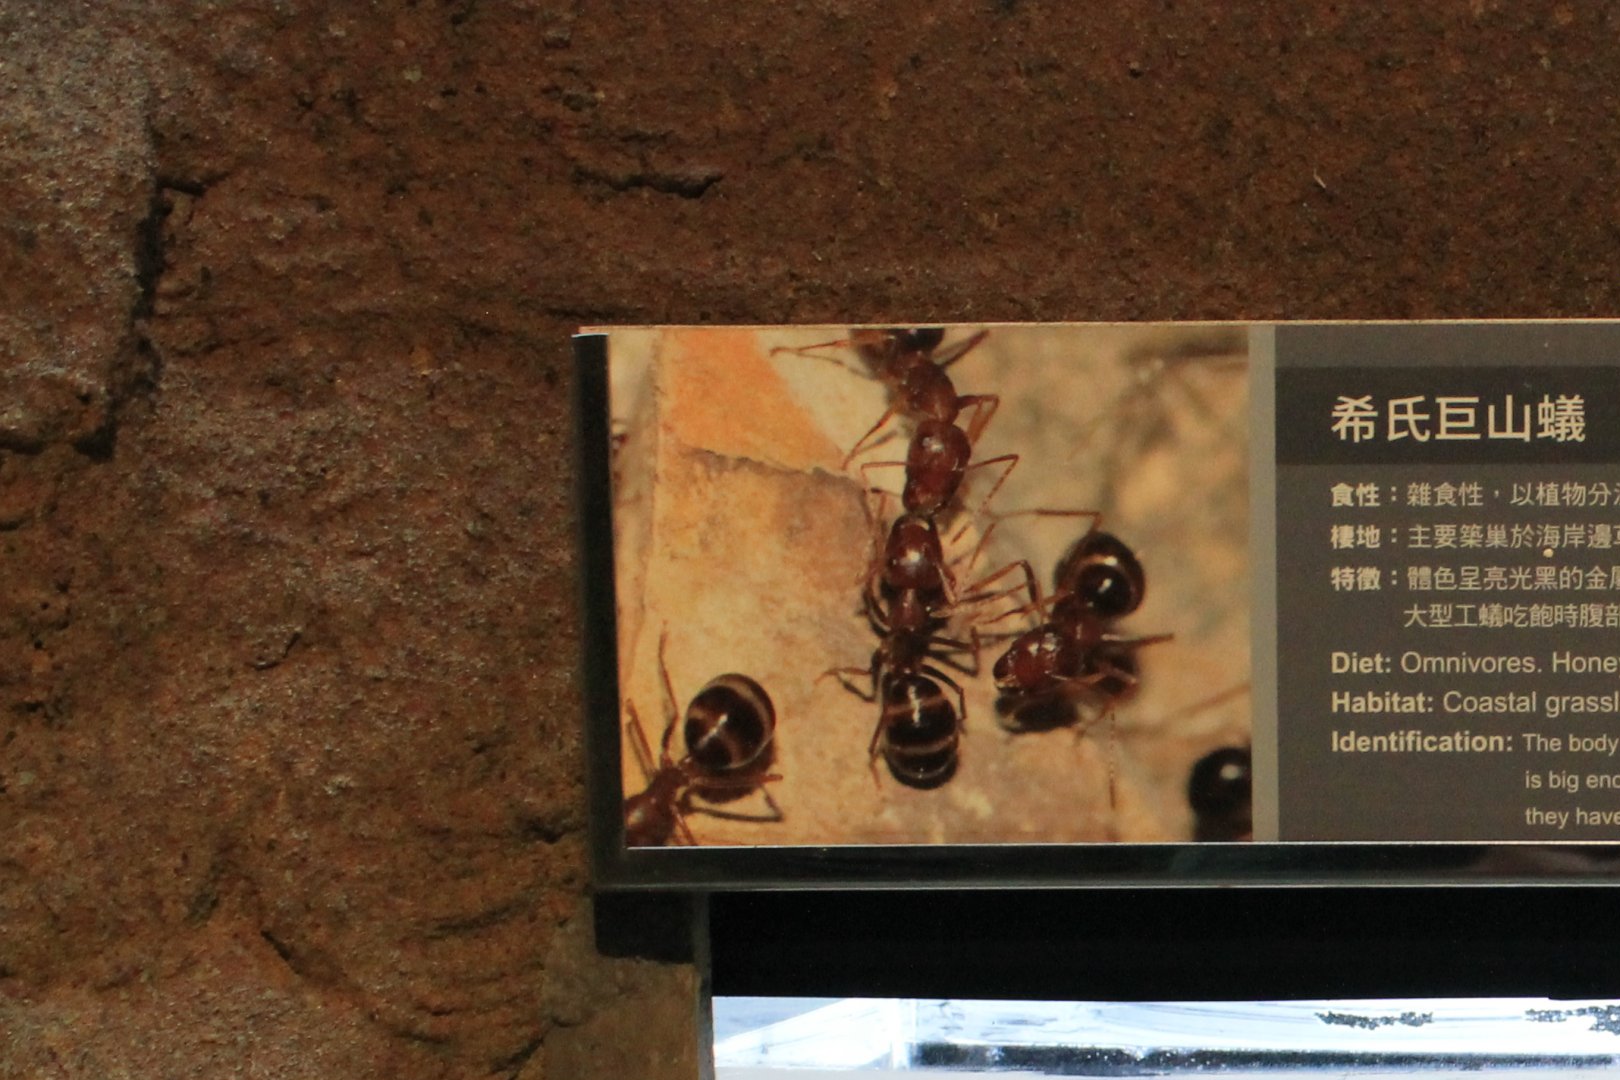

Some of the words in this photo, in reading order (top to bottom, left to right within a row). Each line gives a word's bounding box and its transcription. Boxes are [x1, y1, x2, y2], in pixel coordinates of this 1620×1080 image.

[1330, 393, 1587, 444] 希氏巨山蟻
[1330, 650, 1392, 674] Diet:
[1400, 650, 1543, 674] Omnivores.
[1331, 690, 1434, 714] Habitat:
[1442, 690, 1537, 714] Coastal
[1331, 729, 1513, 753] Identification:
[1521, 732, 1563, 753] The
[1568, 733, 1620, 757] body
[1525, 770, 1543, 789] is
[1548, 770, 1580, 794] big
[1524, 806, 1570, 830] they
